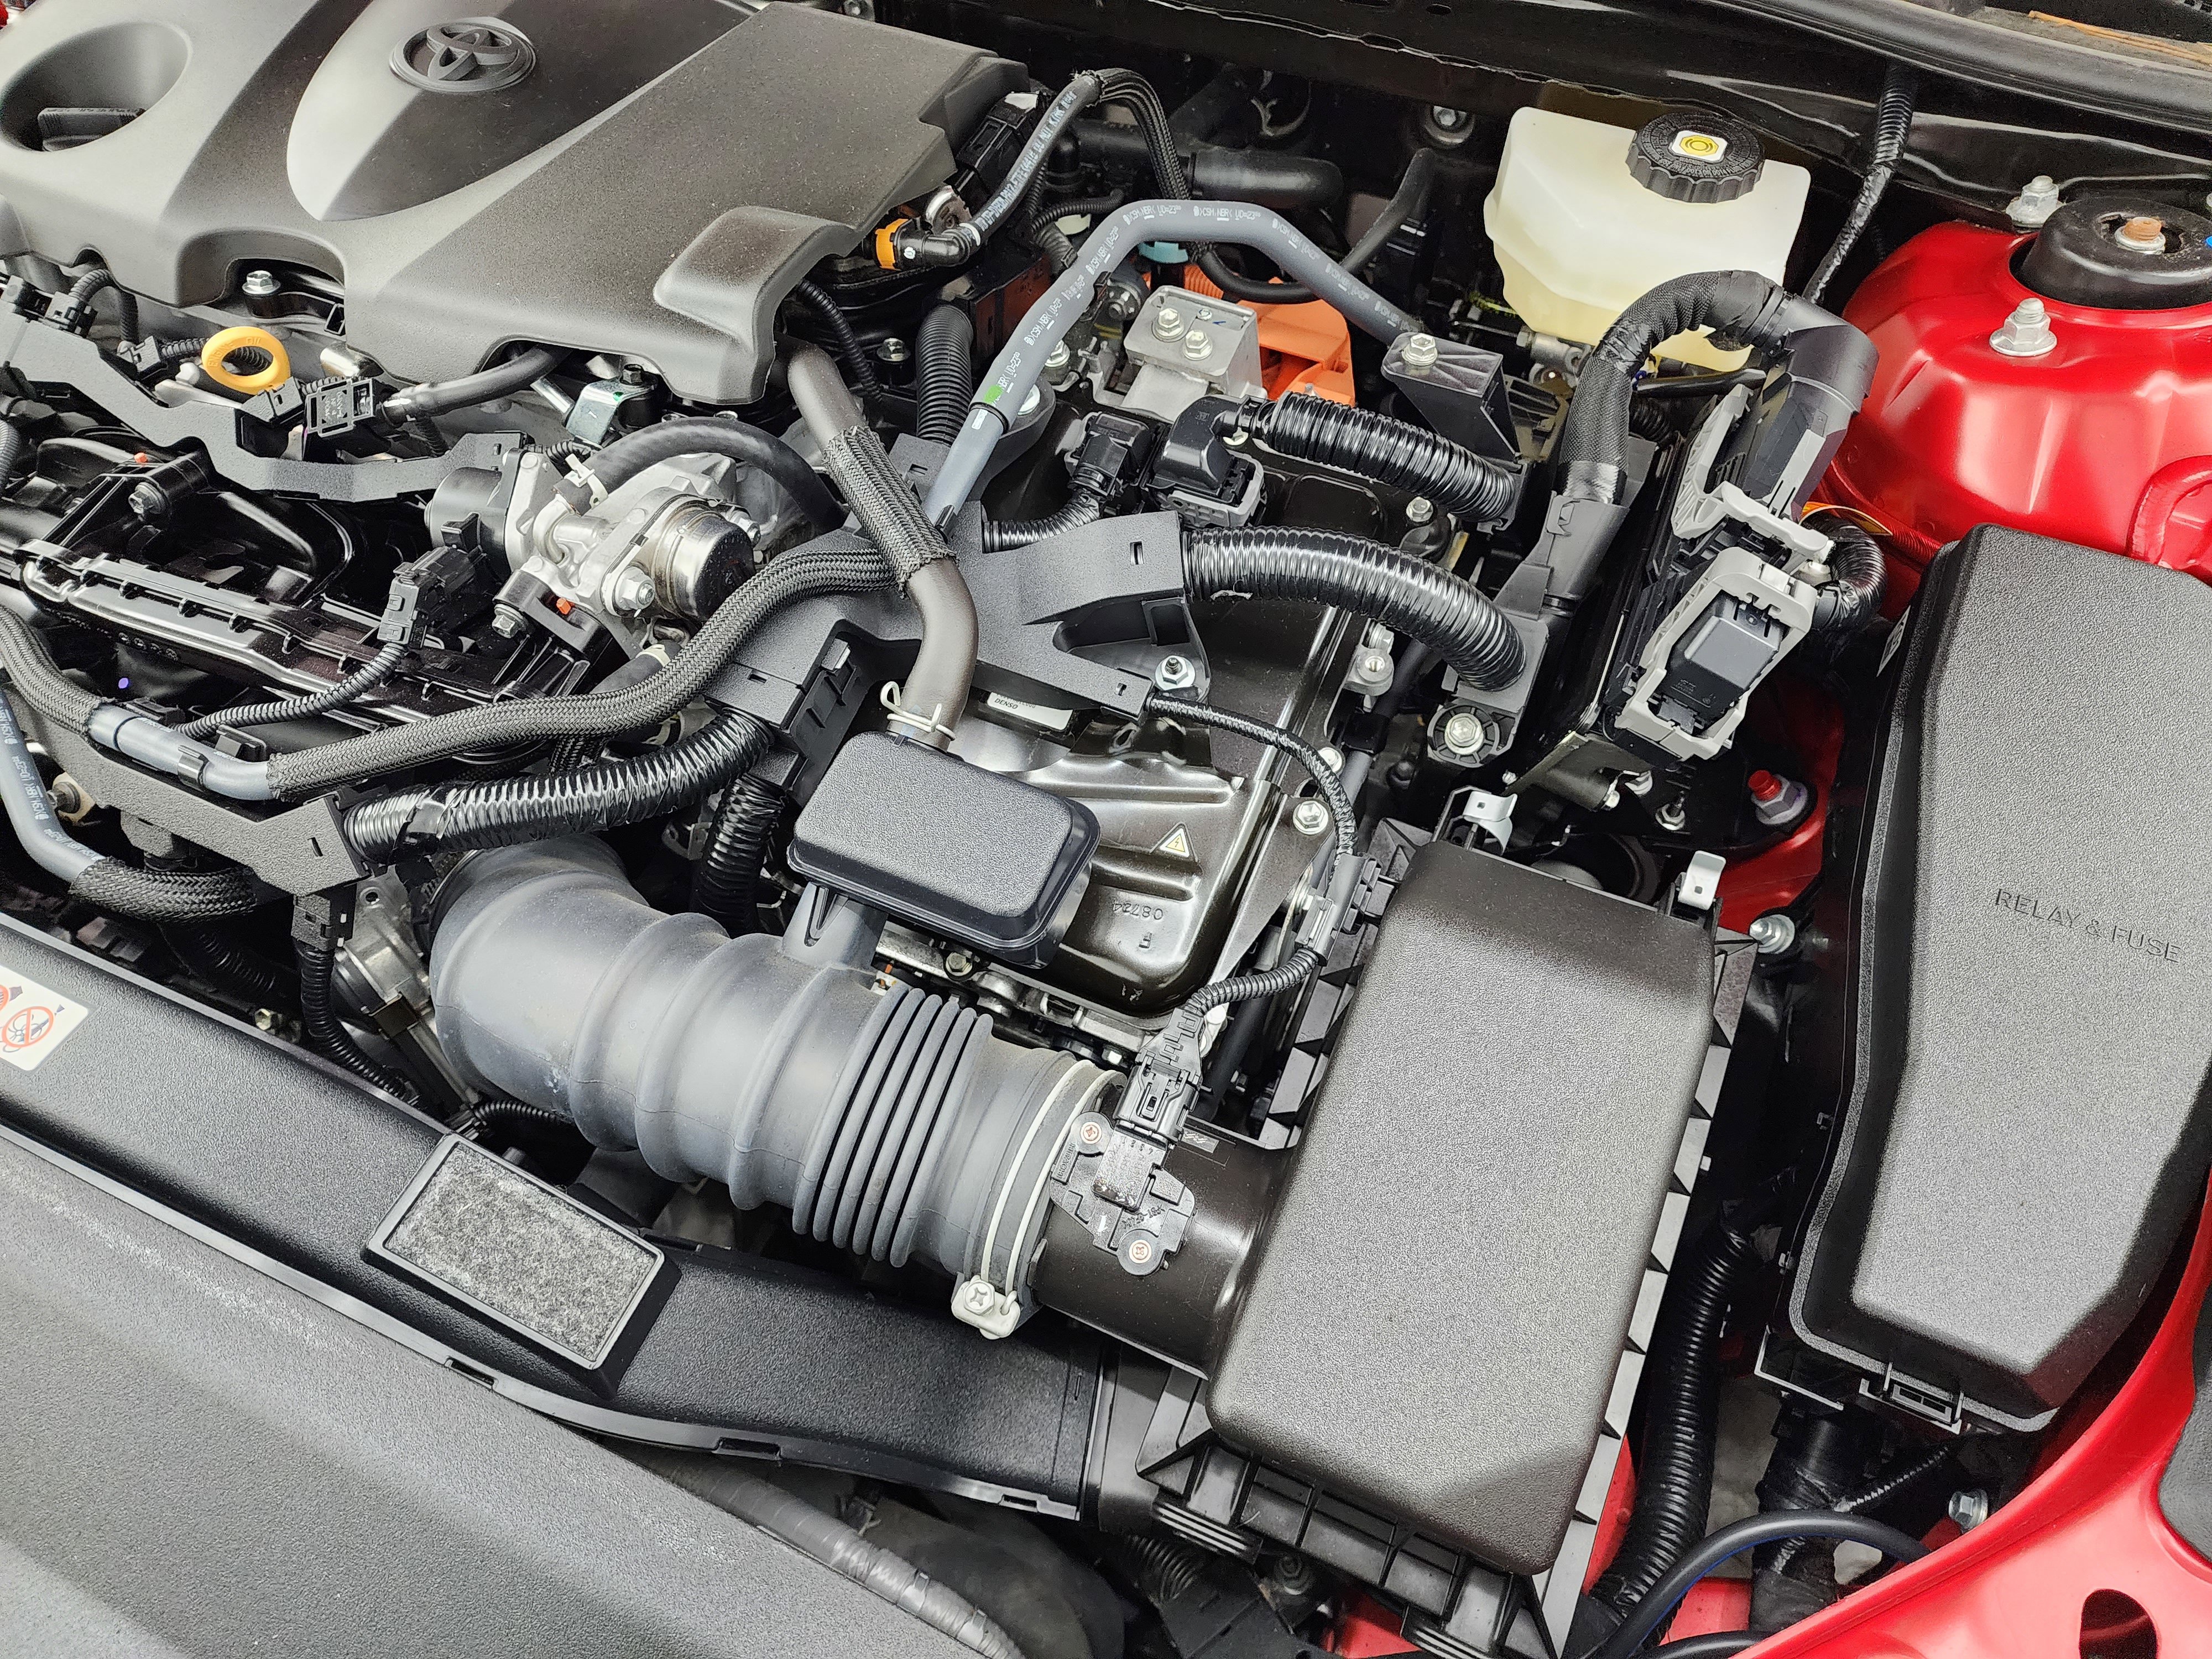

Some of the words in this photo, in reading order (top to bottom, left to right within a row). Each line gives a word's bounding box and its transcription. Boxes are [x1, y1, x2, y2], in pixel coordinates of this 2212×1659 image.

[208, 342, 234, 367] ENGINE
[246, 337, 261, 345] OIL
[994, 698, 1019, 710] DENSO
[1112, 901, 1164, 920] 08724
[1995, 888, 2081, 928] RELAY
[2085, 919, 2102, 937] &
[2112, 925, 2181, 963] FUSE
